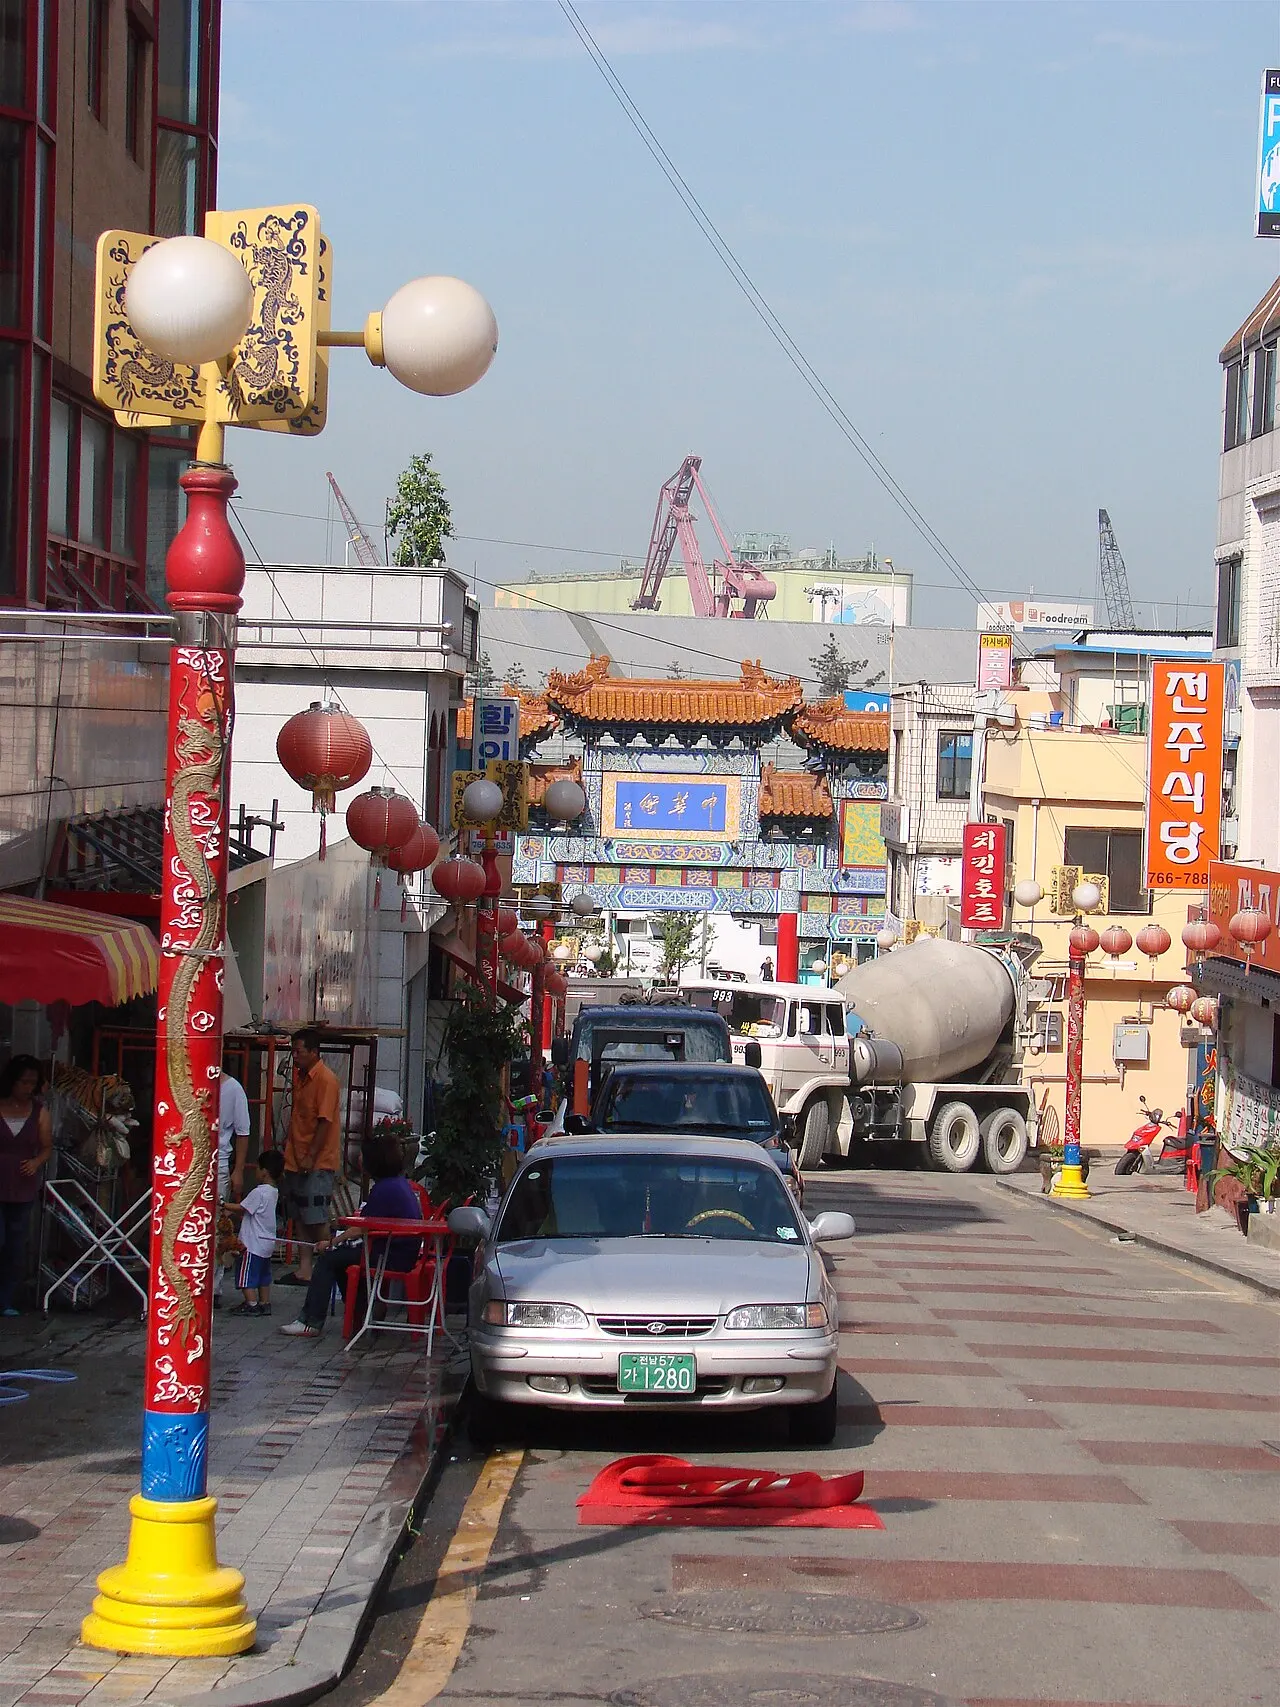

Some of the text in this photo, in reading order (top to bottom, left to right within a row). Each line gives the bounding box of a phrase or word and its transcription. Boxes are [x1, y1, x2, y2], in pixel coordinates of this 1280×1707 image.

[1040, 612, 1088, 624] Foodream
[1160, 672, 1207, 864] 전주식당
[967, 831, 998, 922] 치킨호프
[712, 989, 733, 1003] 993
[623, 1367, 690, 1390] 가 1280
